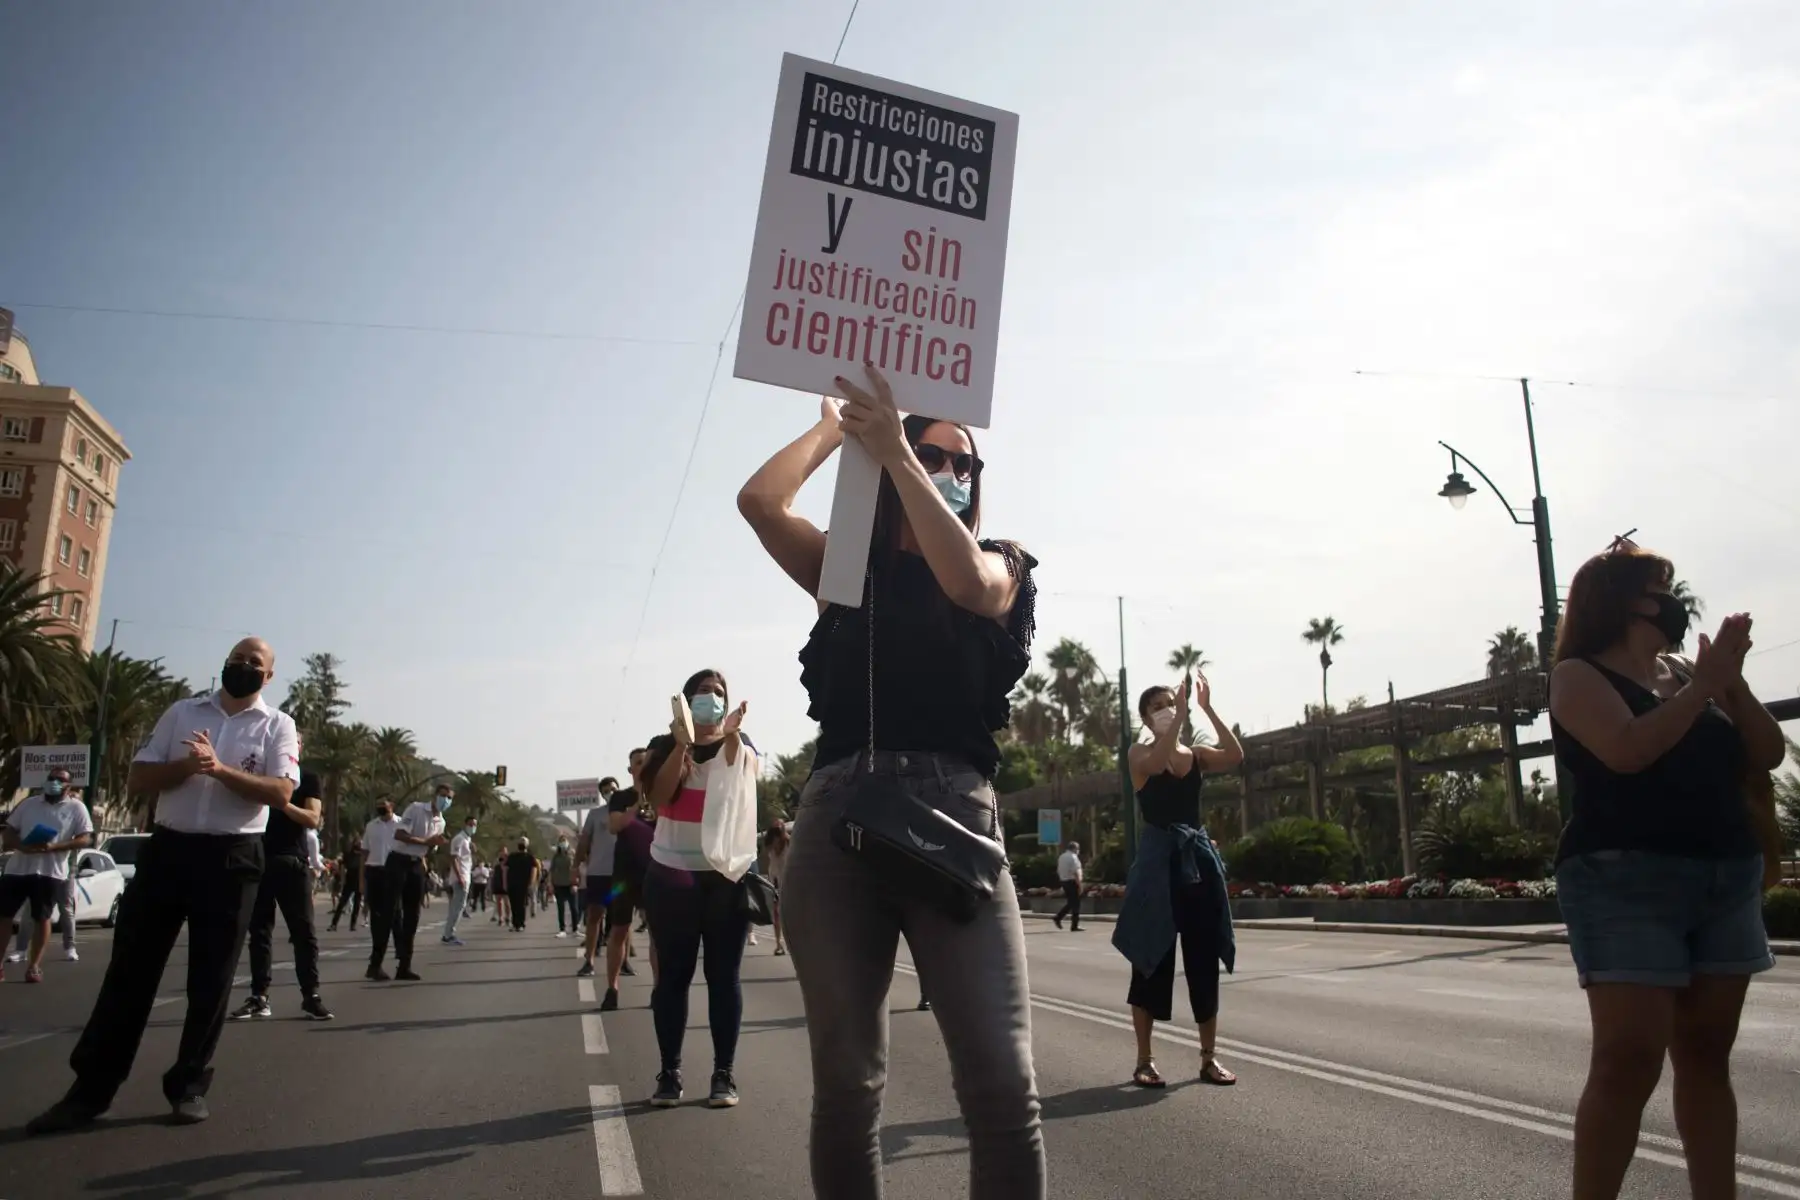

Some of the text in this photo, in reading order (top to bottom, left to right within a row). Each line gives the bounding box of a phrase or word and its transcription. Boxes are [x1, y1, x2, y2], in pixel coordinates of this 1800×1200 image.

[811, 81, 985, 154] Restricciones
[802, 118, 980, 211] injustas
[821, 192, 963, 282] y sin
[773, 248, 977, 330] justificación
[765, 298, 973, 387] científica
[25, 752, 46, 763] Nos
